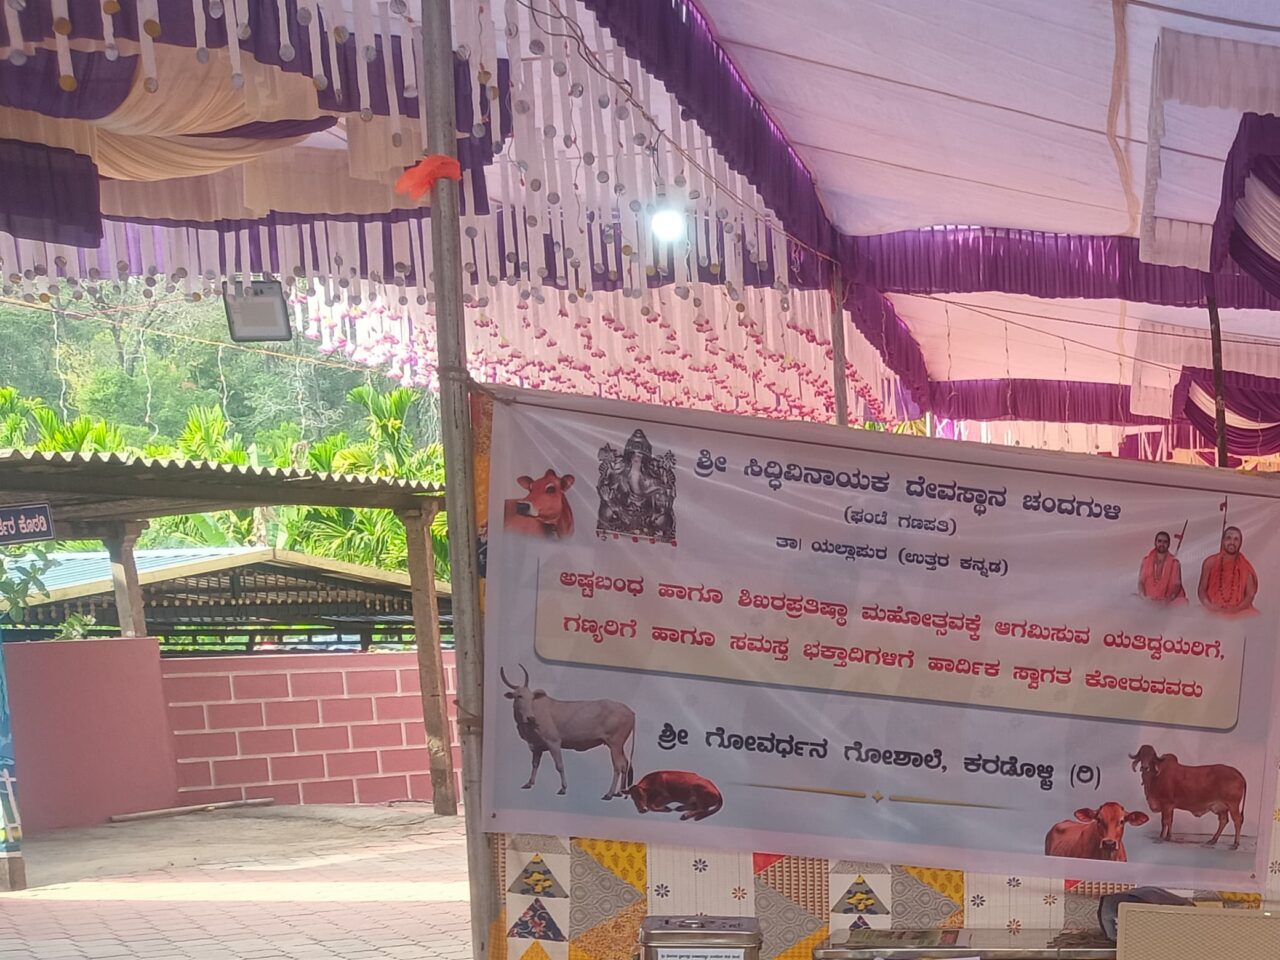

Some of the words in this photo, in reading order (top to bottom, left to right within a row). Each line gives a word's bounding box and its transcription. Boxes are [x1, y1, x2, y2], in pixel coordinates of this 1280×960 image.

[694, 449, 727, 478] ಶ್ರೀ
[743, 457, 890, 493] ಸಿದ್ಧಿವಿನಾಯಕ
[905, 475, 1007, 517] ದೇವಸ್ಥಾನ
[1021, 494, 1122, 521] ಚಂದಗುಳಿ
[843, 505, 888, 527] (ಘಂಟೆ
[898, 513, 957, 537] ಗಣಪತಿ)
[811, 538, 888, 562] ಯಲ್ಲಾಪುರ
[898, 546, 950, 572] (ಉತ್ತರ
[960, 555, 1009, 578] ಕನ್ನಡ)
[559, 570, 644, 598] ಅಷ್ಟಬಂಧ
[658, 582, 723, 605] ಹಾಗೂ
[861, 604, 982, 641] ಮಹೋತ್ಸವಕ್ಕೆ
[994, 617, 1090, 645] ಆಗಮಿಸುವ
[563, 613, 637, 643] ಗಣ್ಯರಿಗೆ
[651, 625, 716, 648] ಹಾಗೂ
[729, 634, 790, 661] ಸಮಸ್ತ
[802, 639, 914, 669] ಭಕ್ತಾದಿಗಳಿಗೆ
[927, 652, 1001, 679] ಹಾರ್ದಿಕ
[1013, 663, 1072, 689] ಸ್ವಾಗತ
[1084, 669, 1203, 698] ಕೋರುವವರು
[657, 722, 689, 750] ಶ್ರೀ
[705, 727, 828, 759] ಗೋವರ್ಧನ
[843, 739, 948, 773] ಗೋಶಾಲೆ,
[1069, 762, 1101, 790] (ರಿ)
